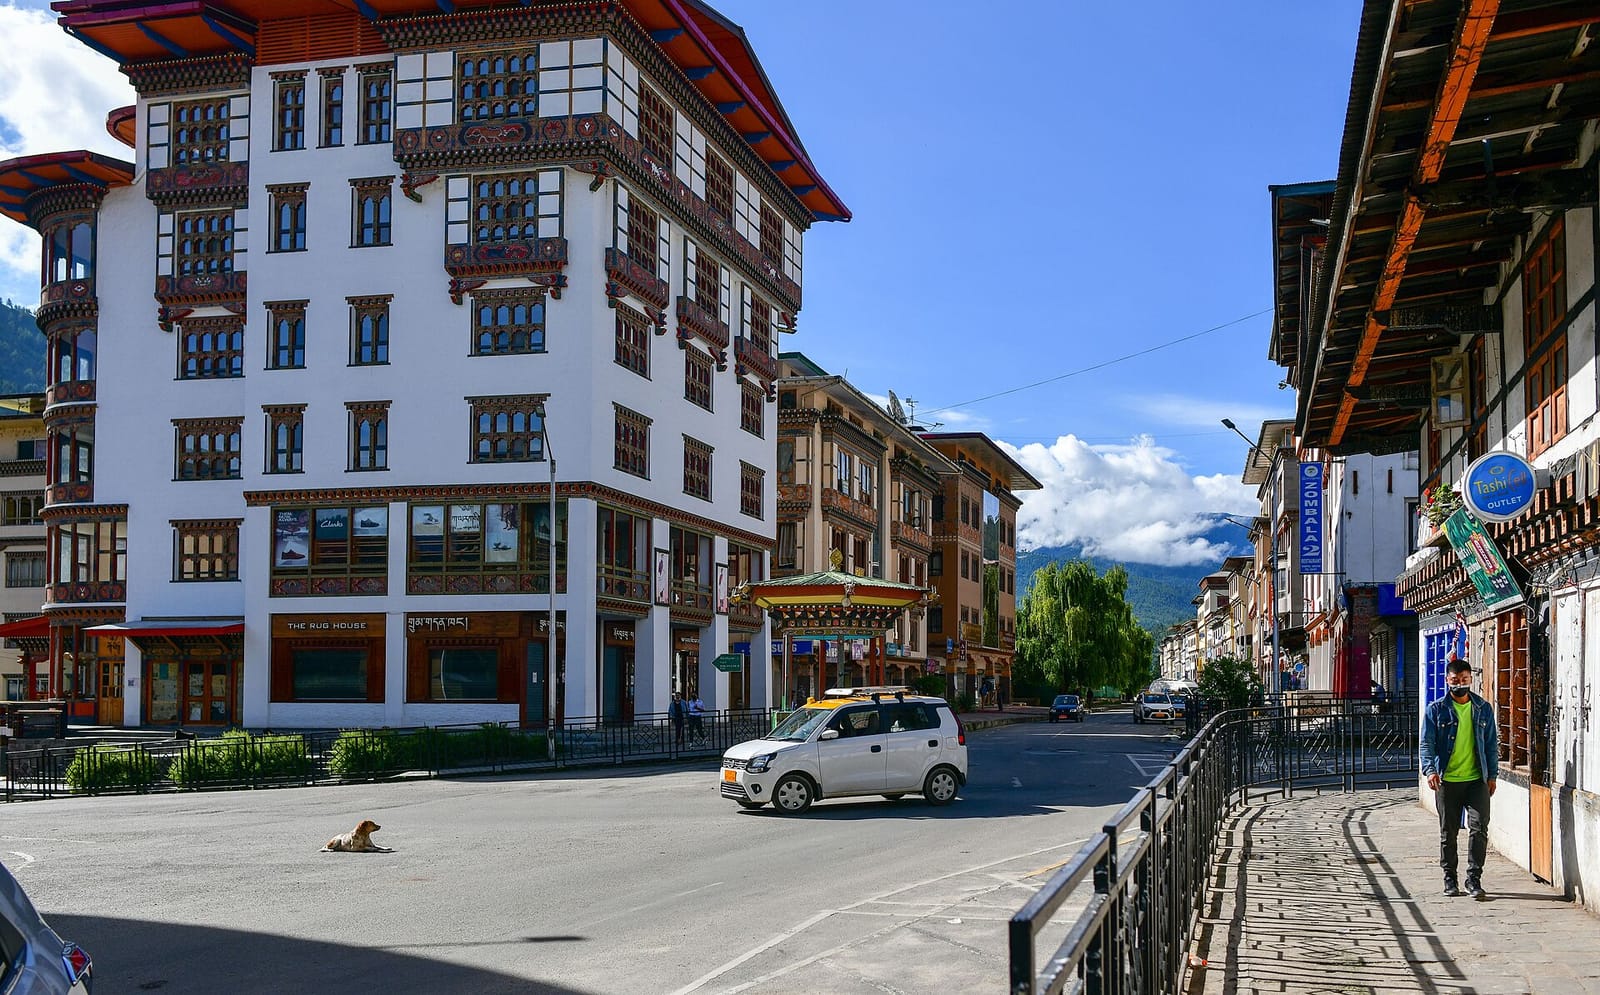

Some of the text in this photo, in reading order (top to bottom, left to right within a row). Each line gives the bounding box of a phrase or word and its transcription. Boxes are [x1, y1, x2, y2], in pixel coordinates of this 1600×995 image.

[1487, 496, 1522, 509] OUTLET
[1304, 482, 1319, 542] ZOMBALA
[320, 520, 344, 528] Clarks
[1302, 545, 1320, 557] 2
[288, 622, 367, 630] THE RUG HOUSE
